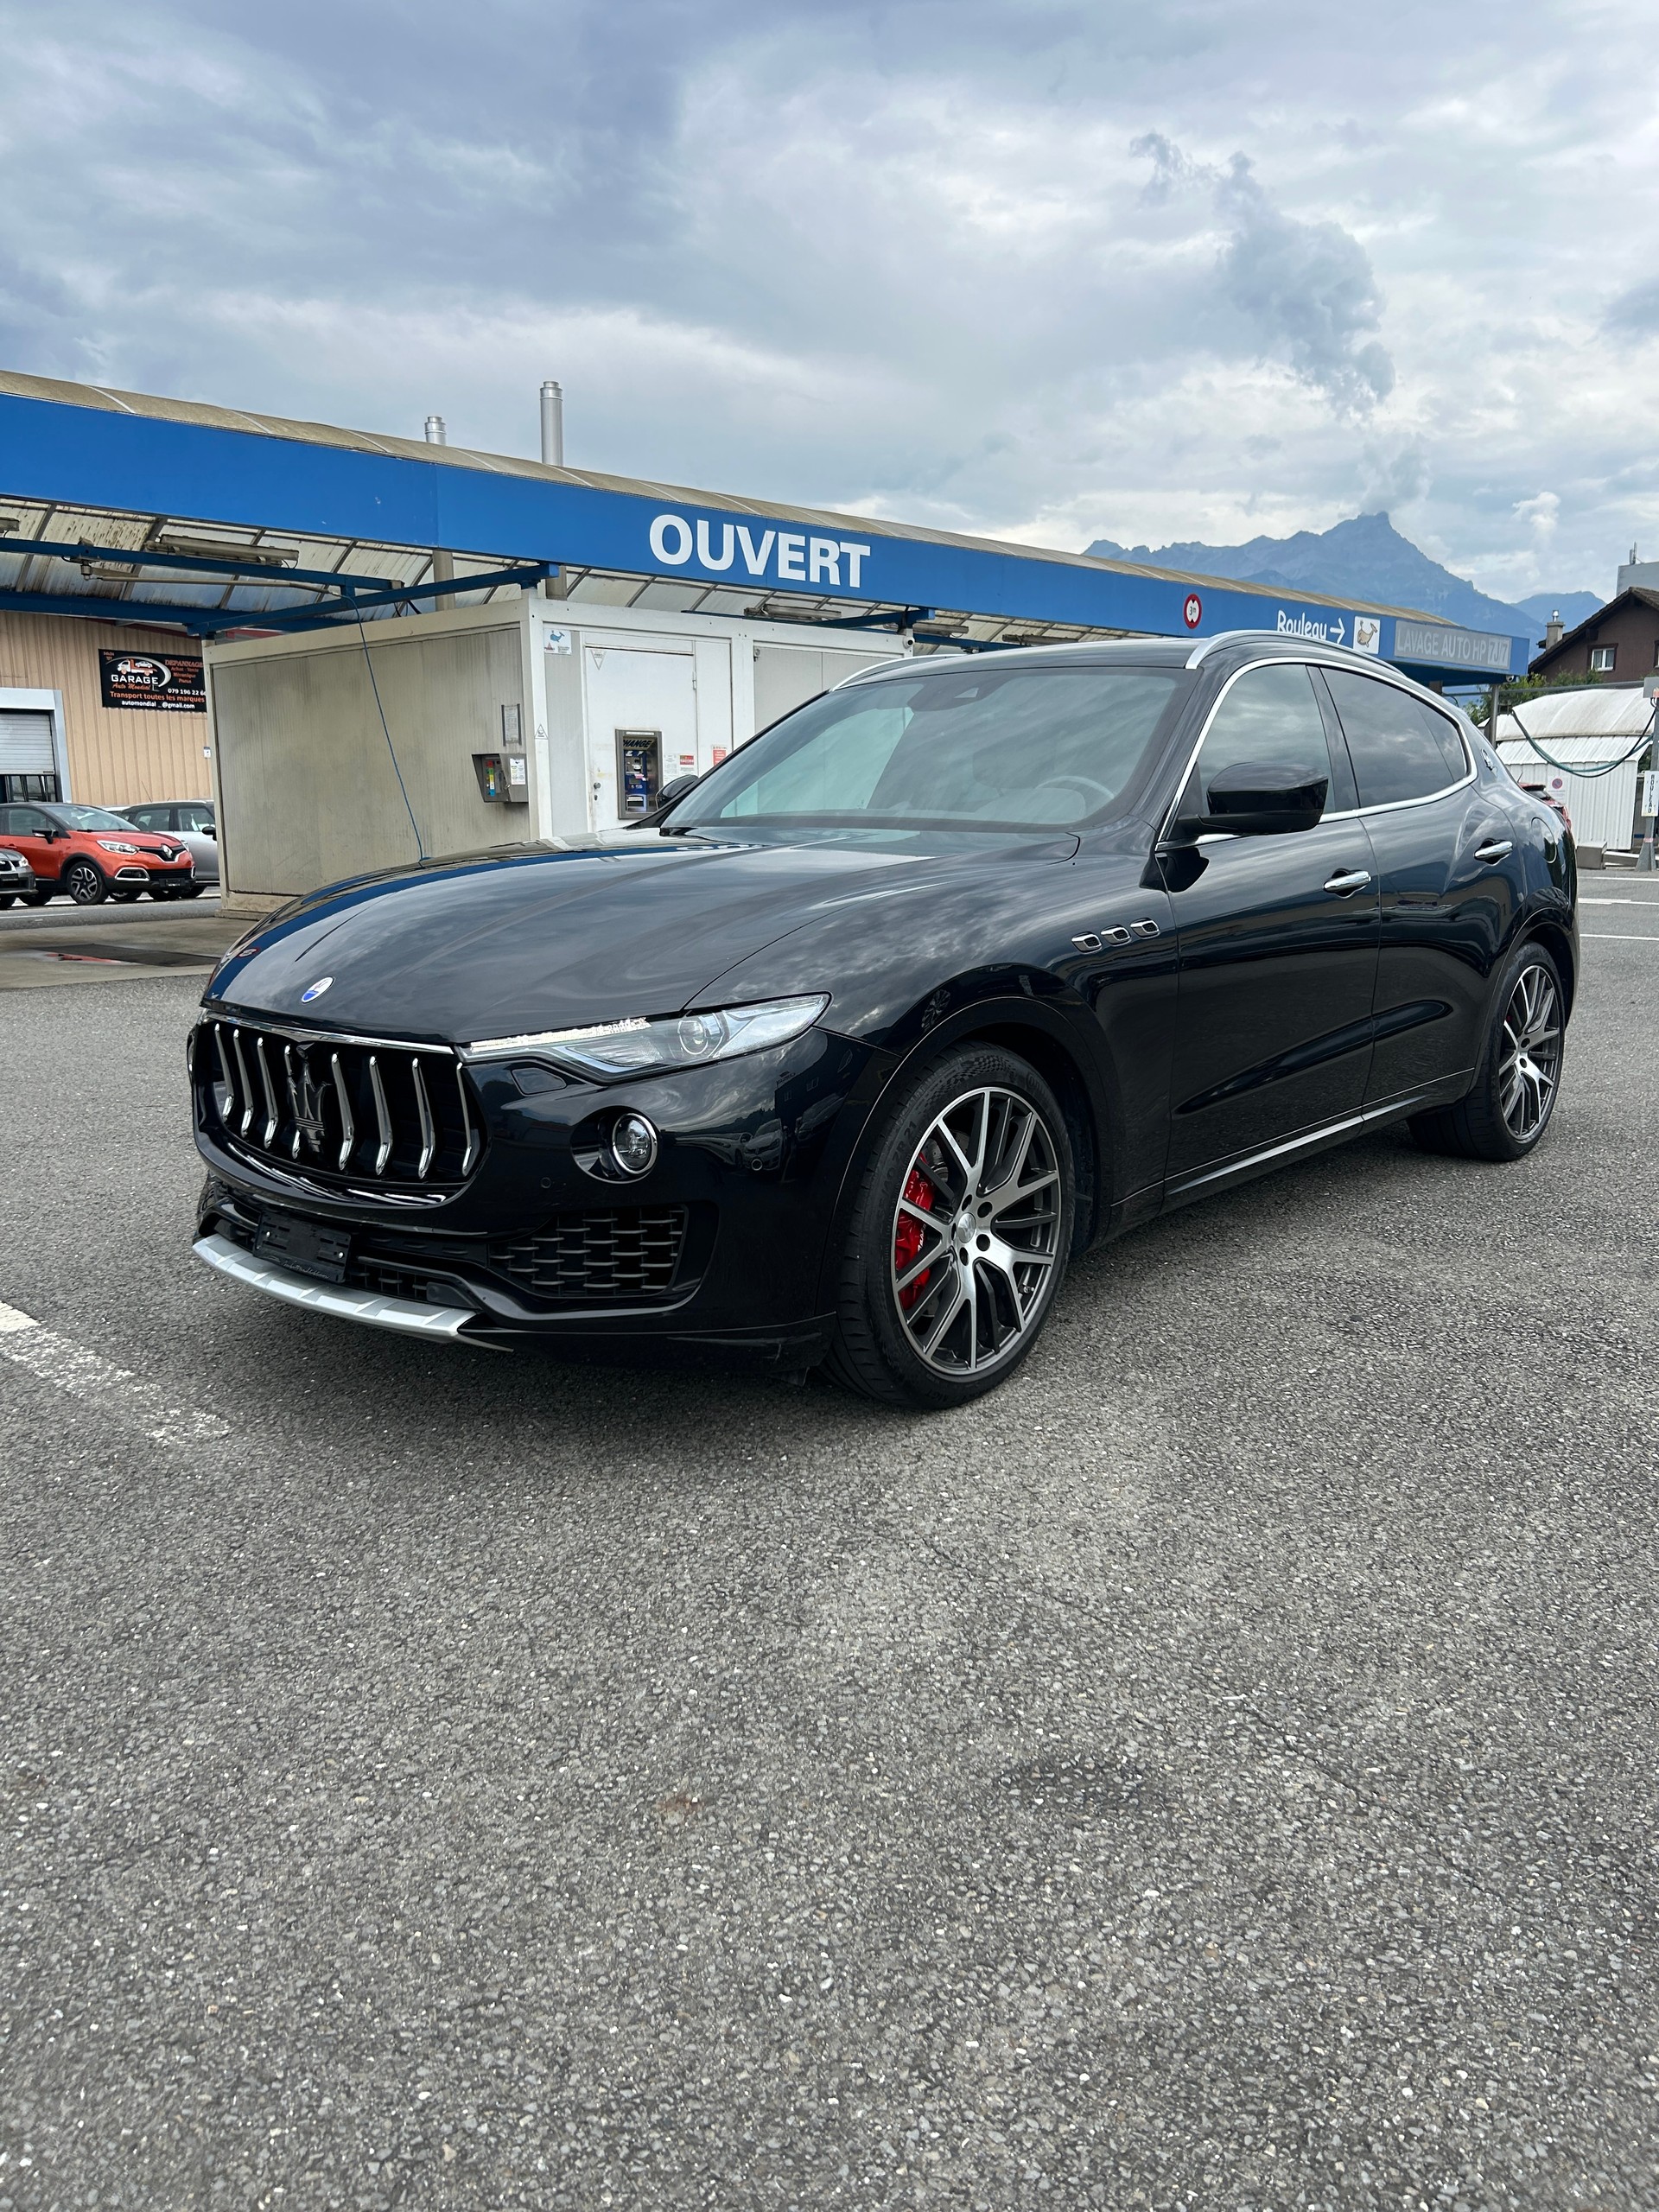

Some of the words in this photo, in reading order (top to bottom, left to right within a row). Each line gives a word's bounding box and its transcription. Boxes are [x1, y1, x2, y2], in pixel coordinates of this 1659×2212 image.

[649, 514, 871, 588] OUVERT
[1277, 609, 1327, 640] Rouleau
[1396, 628, 1440, 655] LAVAGE
[1440, 634, 1471, 658] AUTO
[1471, 639, 1487, 661] HP
[111, 674, 159, 685] GARAGE
[110, 691, 143, 700] Transport
[177, 695, 205, 703] marques
[623, 739, 652, 748] HANGE
